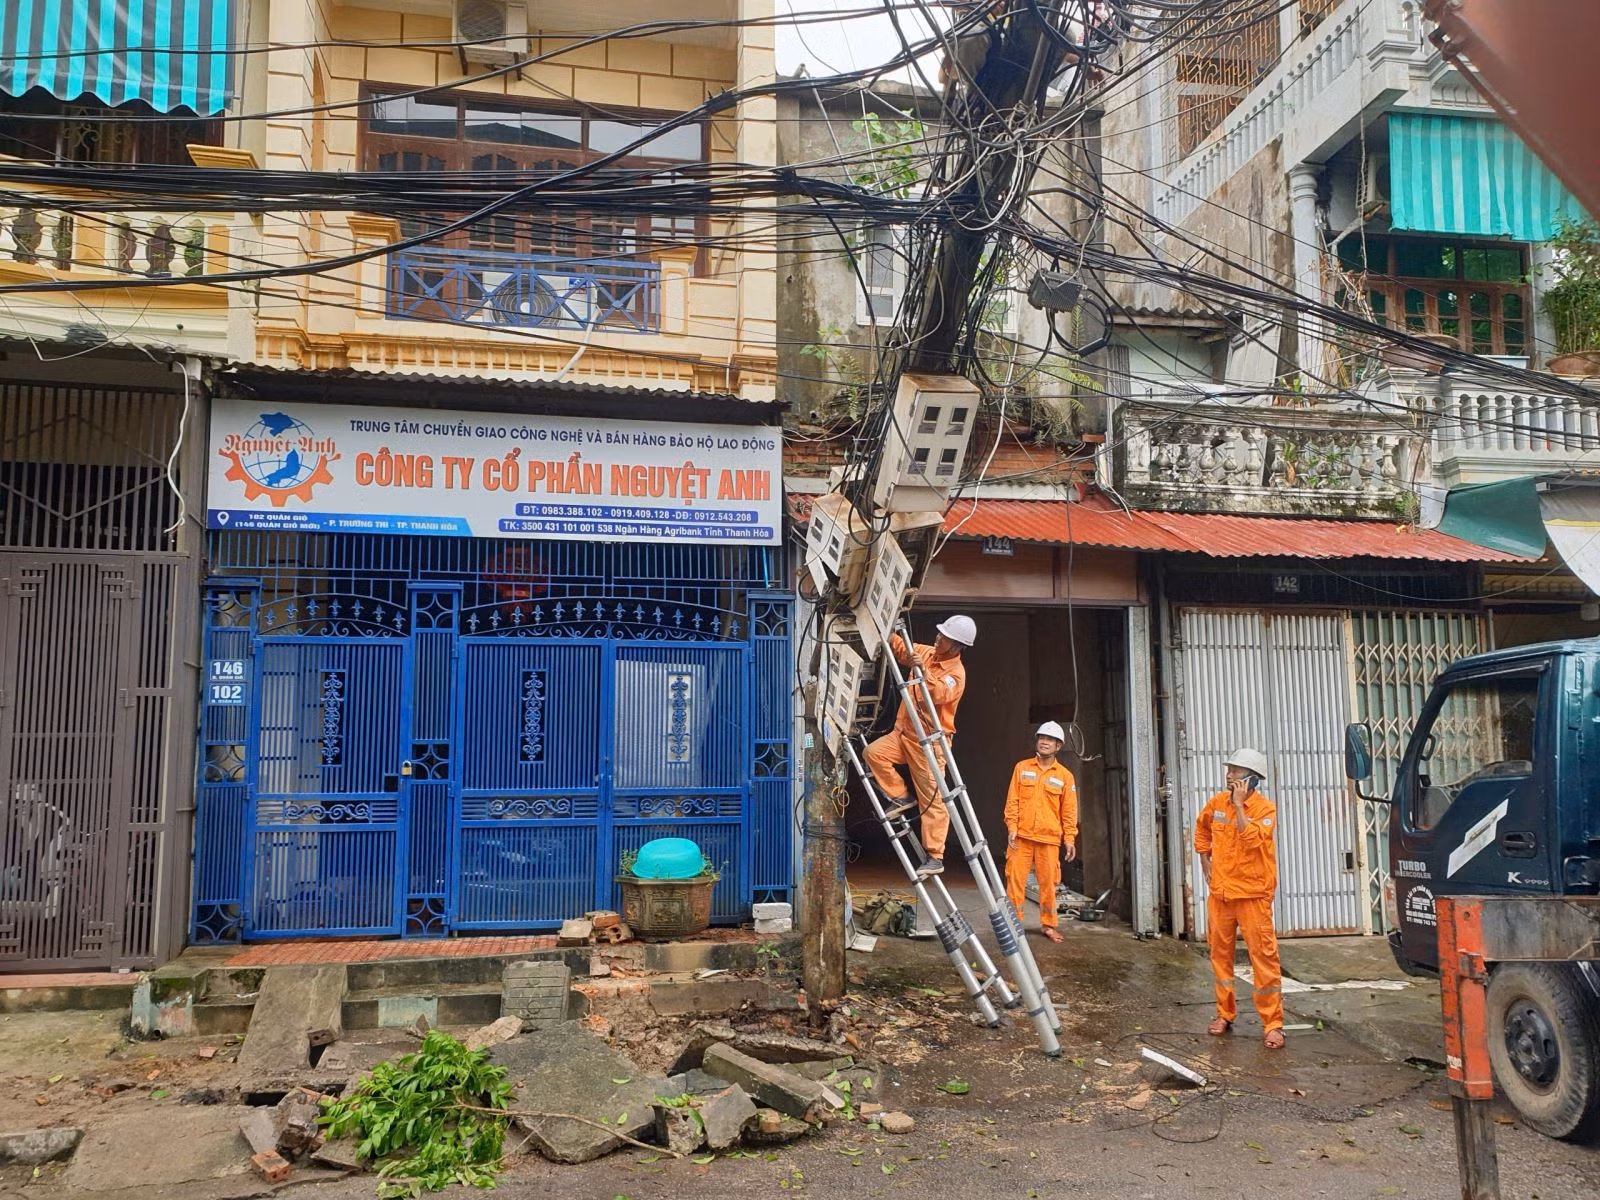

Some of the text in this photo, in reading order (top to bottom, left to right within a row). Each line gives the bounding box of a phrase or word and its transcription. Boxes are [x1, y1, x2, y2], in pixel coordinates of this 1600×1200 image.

[350, 419, 775, 453] TRUNG TÂM CHUYỂN GIAO CÔNG NGHỆ VÀ BÁN HÀNG BẢO HỘ LAO ĐỘNG
[355, 447, 771, 506] CÔNG TY CỔ PHẦN NGUYỆT ANH
[523, 505, 540, 515] ĐT:
[541, 506, 603, 517] 0983.388.102
[610, 508, 670, 519] 0919.409.128
[694, 512, 752, 522] 0912.543.208
[503, 520, 520, 531] TK:
[521, 521, 543, 532] 3500
[544, 522, 560, 532] 431
[563, 523, 577, 532] 101
[580, 523, 595, 533] 001
[597, 524, 613, 533] 538
[615, 524, 638, 535] Ngân
[639, 525, 663, 537] Hàng
[664, 526, 702, 537] Agribank
[725, 527, 751, 537] Thanh
[1276, 576, 1297, 588] 142
[213, 661, 243, 675] 146
[212, 685, 242, 699] 102
[1398, 860, 1427, 873] TURBO
